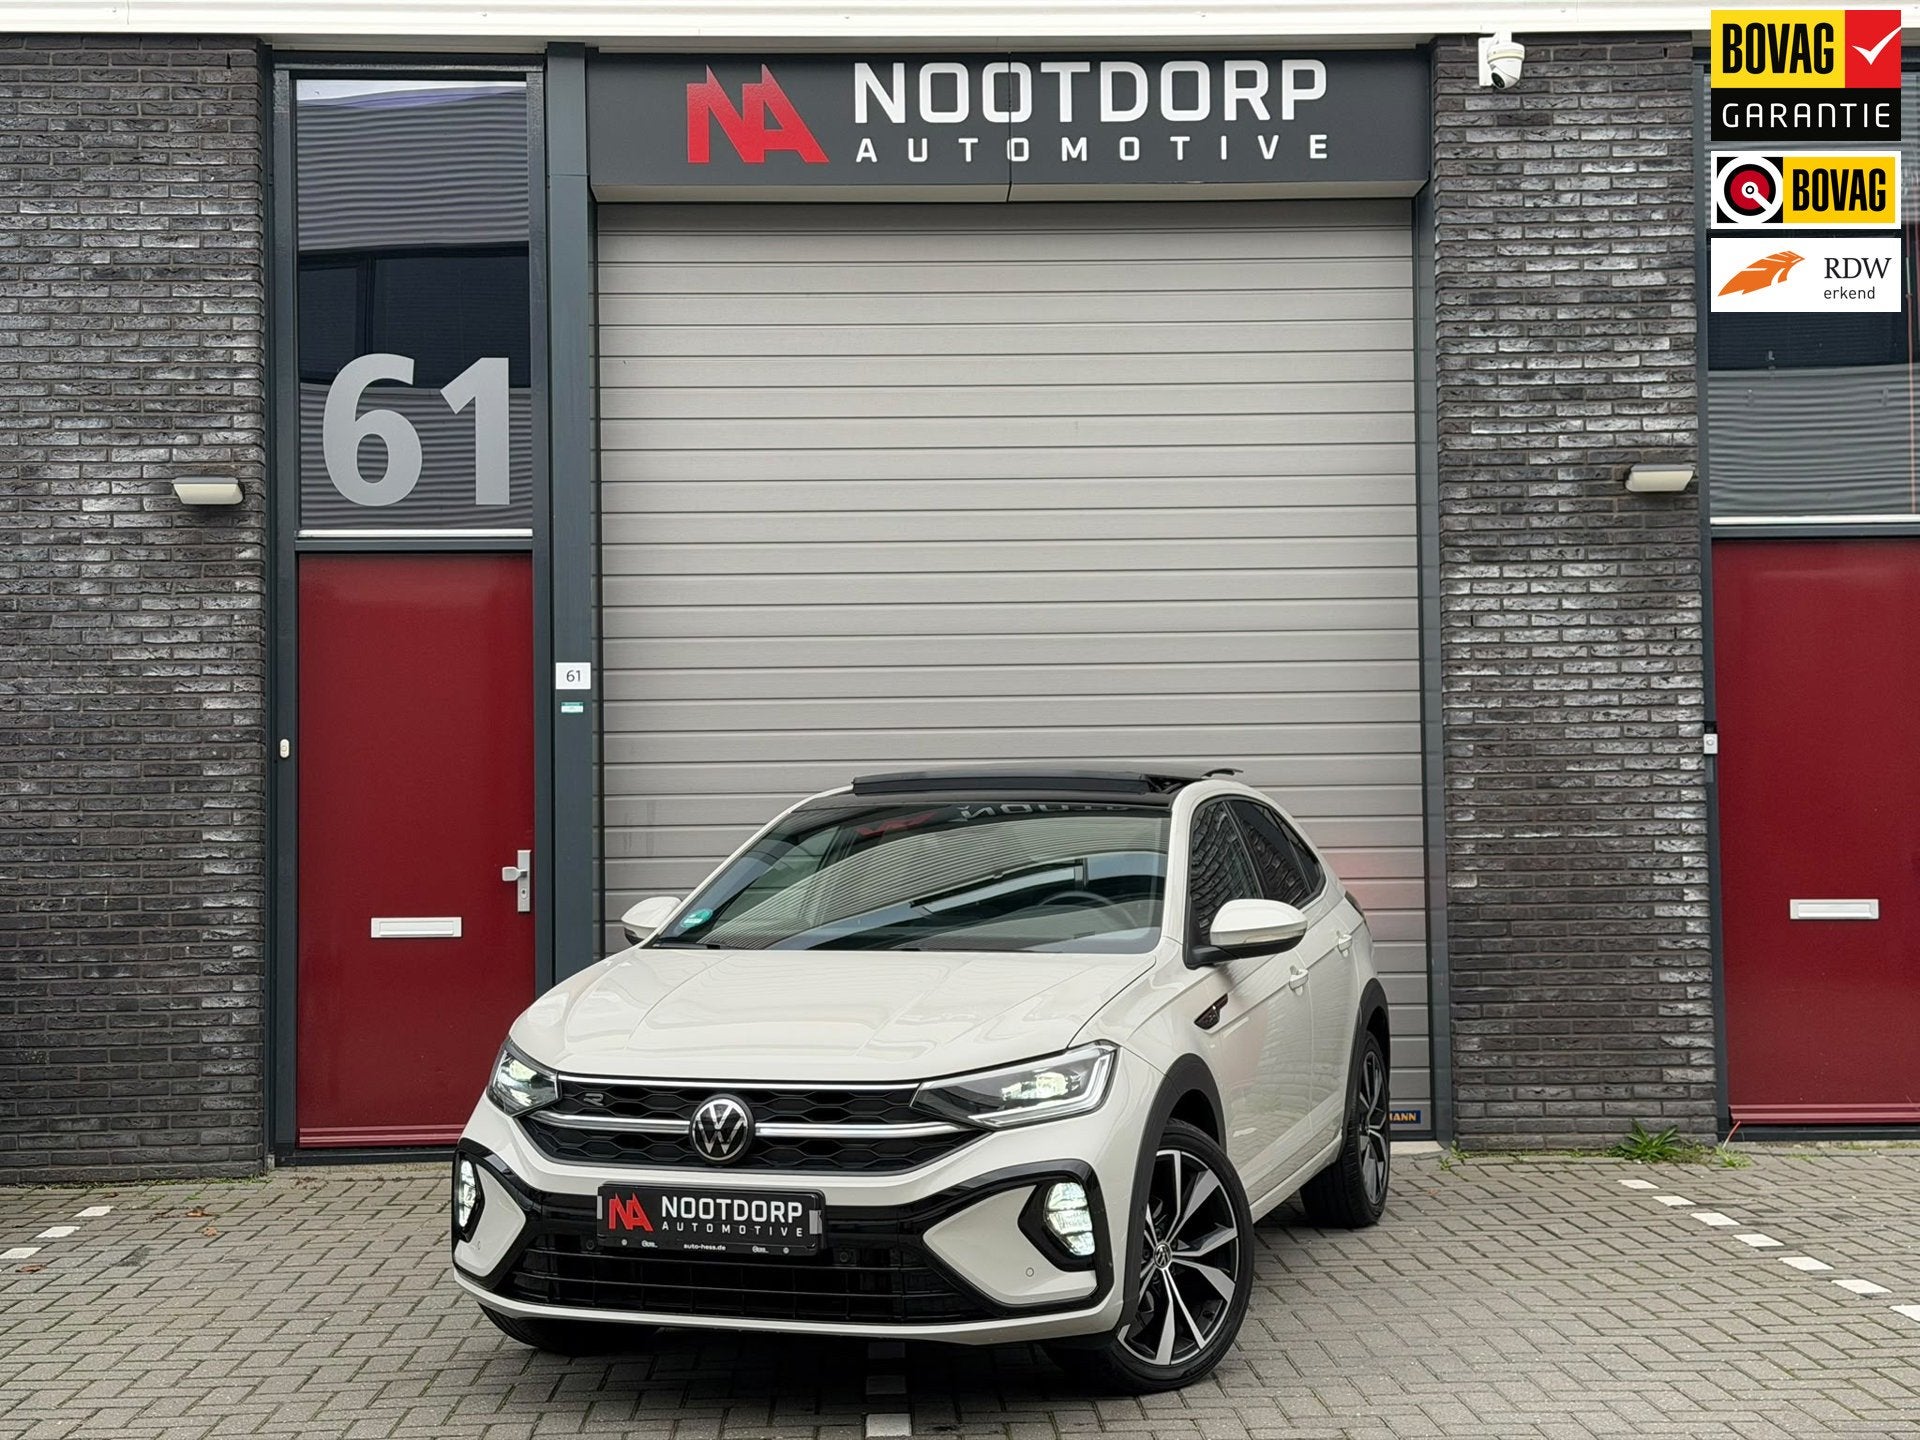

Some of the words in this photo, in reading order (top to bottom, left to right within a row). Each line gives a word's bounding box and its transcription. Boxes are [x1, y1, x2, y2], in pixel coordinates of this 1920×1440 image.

[854, 59, 1328, 125] NOOTDORP
[855, 134, 1328, 163] AUTOMOTIVE
[323, 353, 510, 507] 61
[566, 669, 581, 682] 61
[661, 1195, 803, 1224] NOOTDORP
[661, 1220, 803, 1237] AUTOMOTIVE
[683, 1243, 726, 1251] auto-hess.de
